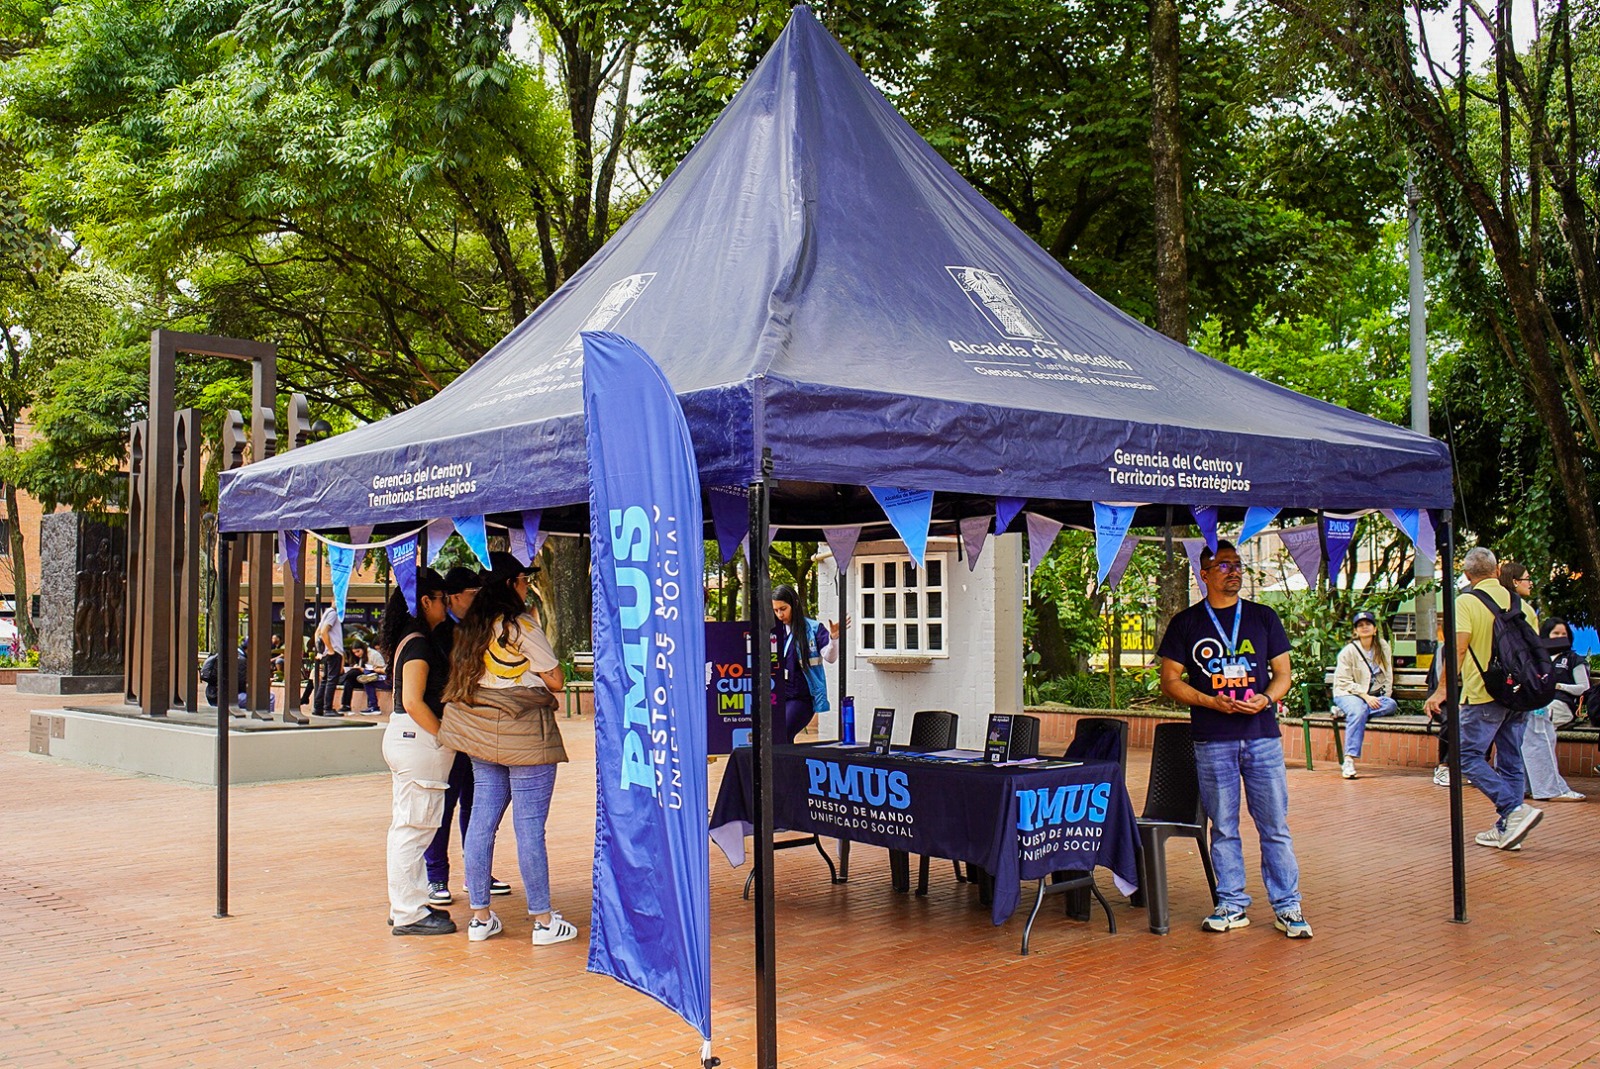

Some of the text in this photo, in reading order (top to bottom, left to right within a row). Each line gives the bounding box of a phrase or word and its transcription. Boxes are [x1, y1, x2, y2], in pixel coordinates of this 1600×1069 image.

[1031, 344, 1058, 359] de
[372, 461, 473, 490] Gerencia del Centro y
[1114, 448, 1243, 476] Gerencia del Centro y
[368, 478, 477, 508] Territorios Estratégicos
[1108, 466, 1251, 493] Territorios Estratégicos
[1328, 520, 1351, 532] PMUS
[609, 505, 657, 799] PMUS
[716, 663, 744, 678] YO
[716, 678, 776, 693] CUI
[805, 758, 911, 810] PMUS
[808, 798, 914, 825] PUESTO DE MANDO
[1016, 782, 1111, 832] PMUS
[810, 811, 914, 838] UNIFICADO SOCIAL
[1048, 828, 1063, 839] DE
[1065, 826, 1103, 838] MAND
